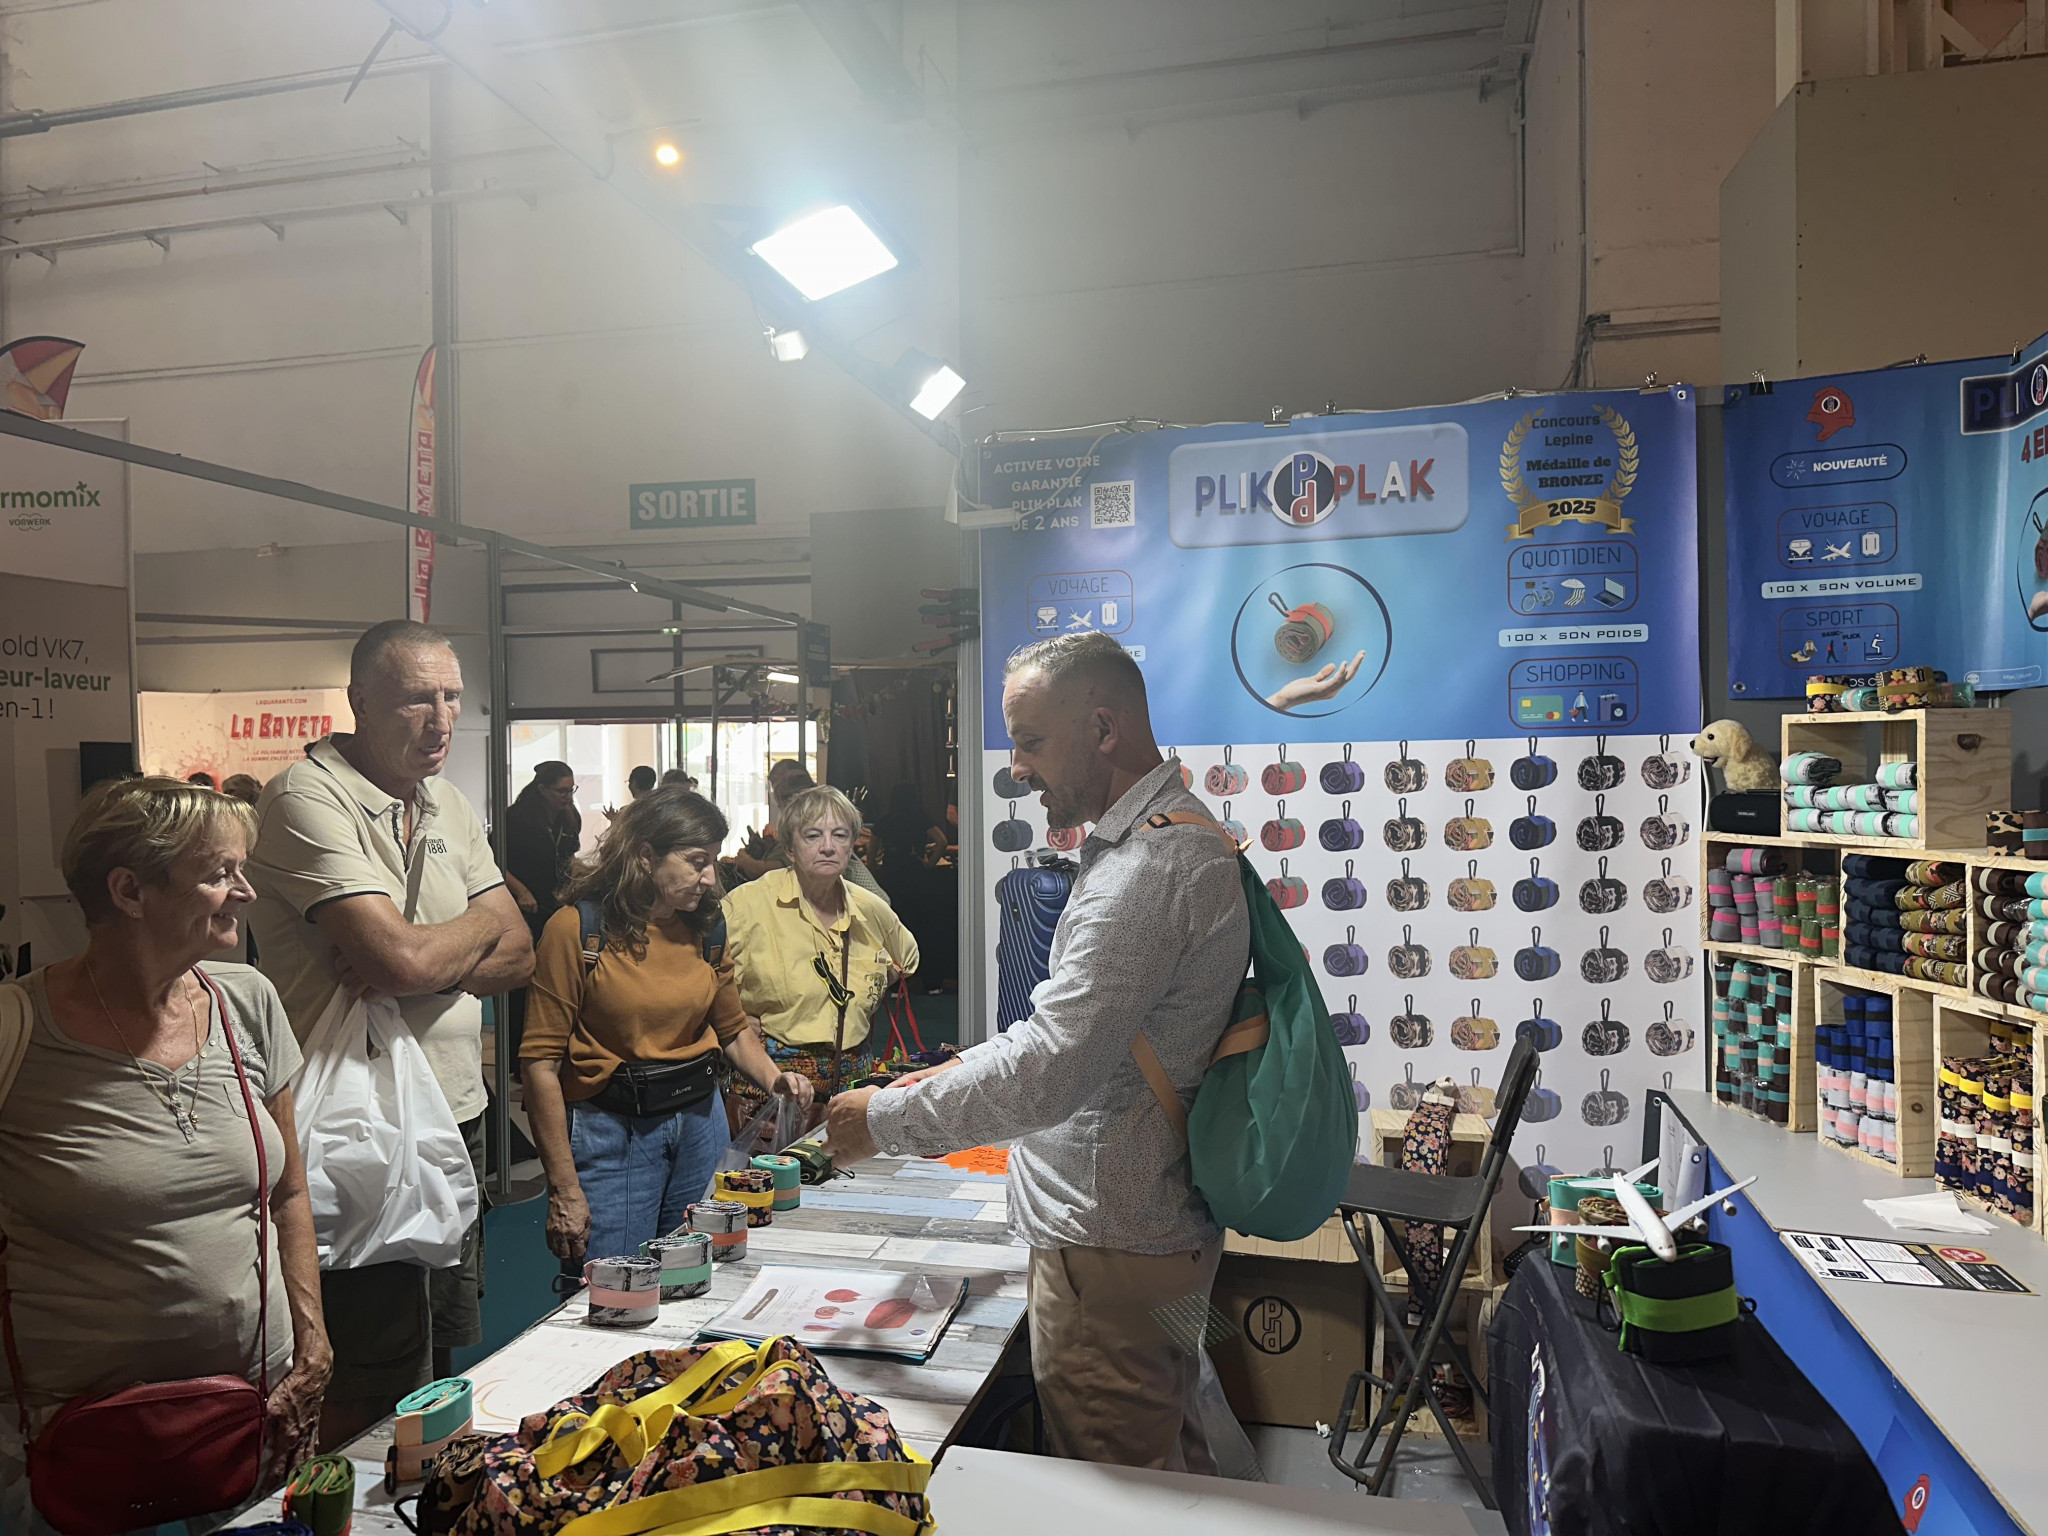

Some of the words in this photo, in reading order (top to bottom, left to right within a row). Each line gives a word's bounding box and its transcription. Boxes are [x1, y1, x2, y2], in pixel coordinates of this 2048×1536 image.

[1531, 415, 1600, 429] Concours
[1545, 433, 1594, 448] Lepine
[993, 459, 1052, 474] ACTIVEZ
[1056, 455, 1100, 469] VOTRE
[1526, 456, 1590, 472] Médaille
[1593, 456, 1612, 467] de
[1813, 454, 1888, 472] NOUVEAUTÉ
[1012, 477, 1082, 492] GARANTIE
[1195, 470, 1274, 512] PLIK
[1332, 458, 1435, 503] PLAK
[1538, 474, 1604, 489] BRONZE
[638, 487, 748, 521] SORTIE
[1547, 500, 1597, 518] 2025
[9, 518, 51, 526] VORWERK
[1034, 515, 1046, 531] 2
[1050, 515, 1080, 529] ANS
[1801, 508, 1870, 529] VOYAGE
[1522, 546, 1621, 570] QUOTIDIEN
[1048, 576, 1109, 596] VOYAGE
[1769, 585, 1795, 594] 100
[1819, 582, 1849, 591] SON
[1855, 577, 1917, 589] VOLUME
[1806, 609, 1864, 627] SPORT
[1507, 633, 1534, 642] 100
[1559, 631, 1590, 640] SON
[1597, 629, 1642, 639] POIDS
[2, 634, 38, 658] old
[43, 637, 88, 664] VK7,
[1526, 662, 1625, 683] SHOPPING
[427, 842, 448, 855] 1881
